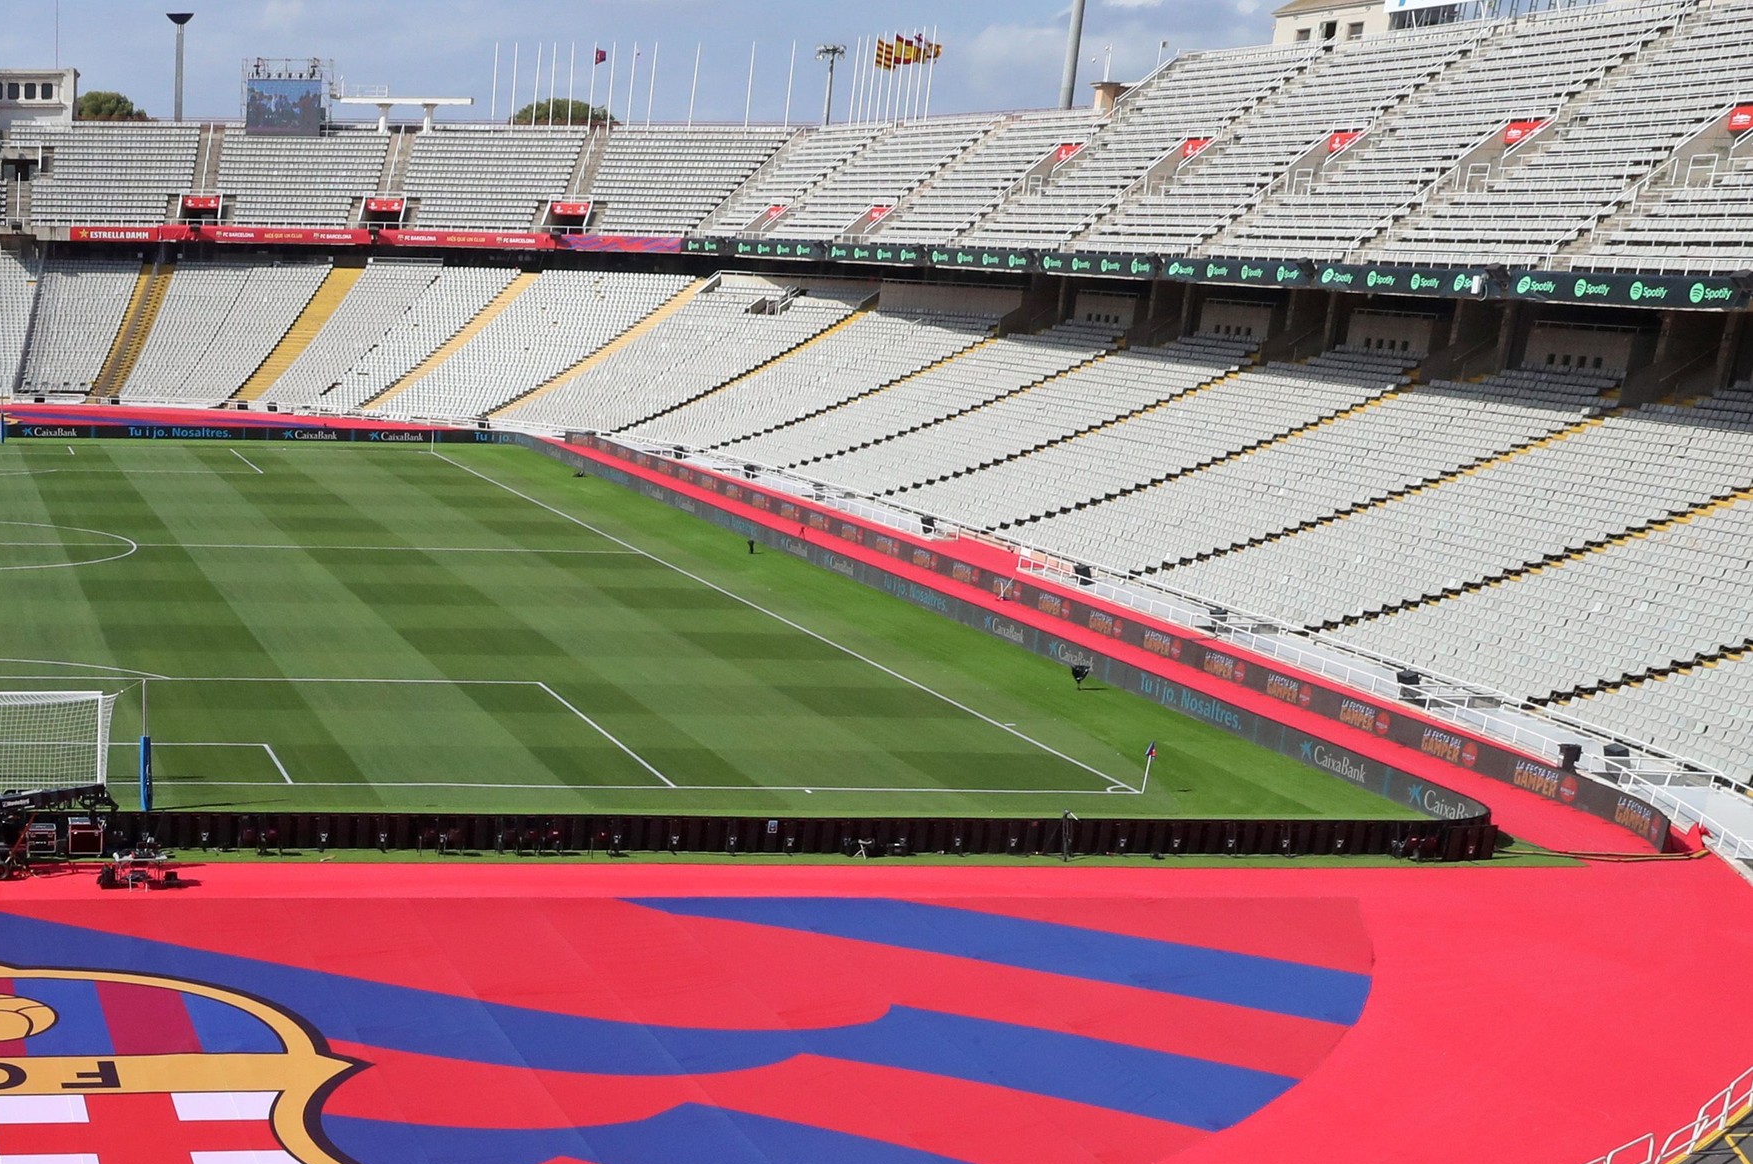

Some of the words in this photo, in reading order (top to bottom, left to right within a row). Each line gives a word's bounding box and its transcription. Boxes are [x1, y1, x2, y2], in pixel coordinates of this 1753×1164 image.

[90, 231, 125, 239] ESTRELLA
[126, 231, 149, 239] DAMM
[1420, 277, 1440, 289] Spotify
[1530, 280, 1556, 294] Spotify
[1586, 283, 1610, 296] Spotify
[1643, 286, 1668, 299] Spotify
[1704, 287, 1732, 301] Spotify
[34, 427, 77, 437] CaixaBank
[128, 427, 141, 436] Tu
[153, 427, 168, 439] jo.
[172, 427, 232, 438] Nosaltres.
[295, 430, 337, 440] CaixaBank
[381, 432, 424, 442] CaixaBank
[474, 432, 488, 441] Tu
[1141, 672, 1152, 694] Tu
[1162, 682, 1176, 705] jo.
[1180, 689, 1241, 730] Nosaltres.
[1421, 737, 1460, 762] GAMPER
[1314, 745, 1366, 783] CaixaBank
[1514, 770, 1558, 798] GAMPER
